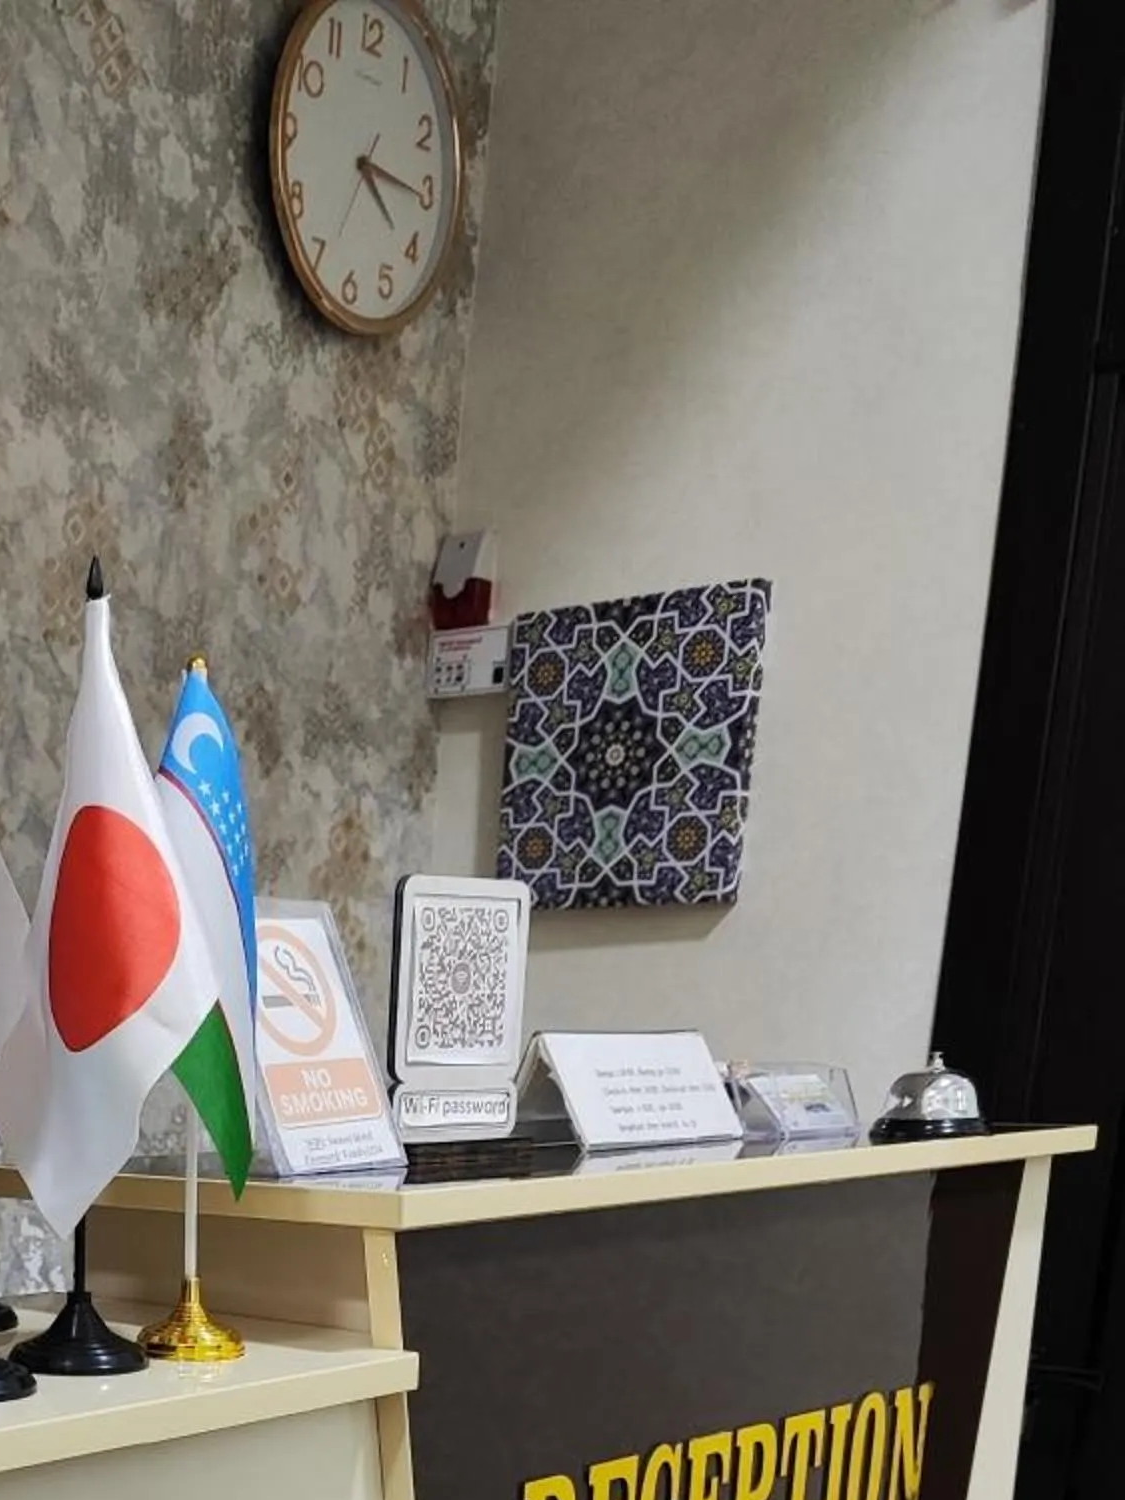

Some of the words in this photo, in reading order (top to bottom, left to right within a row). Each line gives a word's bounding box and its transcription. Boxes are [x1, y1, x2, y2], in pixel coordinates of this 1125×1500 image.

[328, 17, 342, 59] 11
[361, 13, 384, 58] 12
[297, 53, 325, 98] 10
[401, 56, 410, 93] 1
[284, 112, 298, 148] 9
[416, 115, 433, 151] 2
[291, 180, 304, 220] 8
[419, 175, 434, 210] 3
[311, 236, 326, 272] 7
[404, 232, 419, 264] 4
[341, 270, 357, 304] 6
[378, 264, 394, 299] 5
[300, 1068, 332, 1091] NO
[280, 1087, 369, 1117] SMOKING
[402, 1096, 440, 1115] Wi-Fi
[442, 1097, 507, 1117] password
